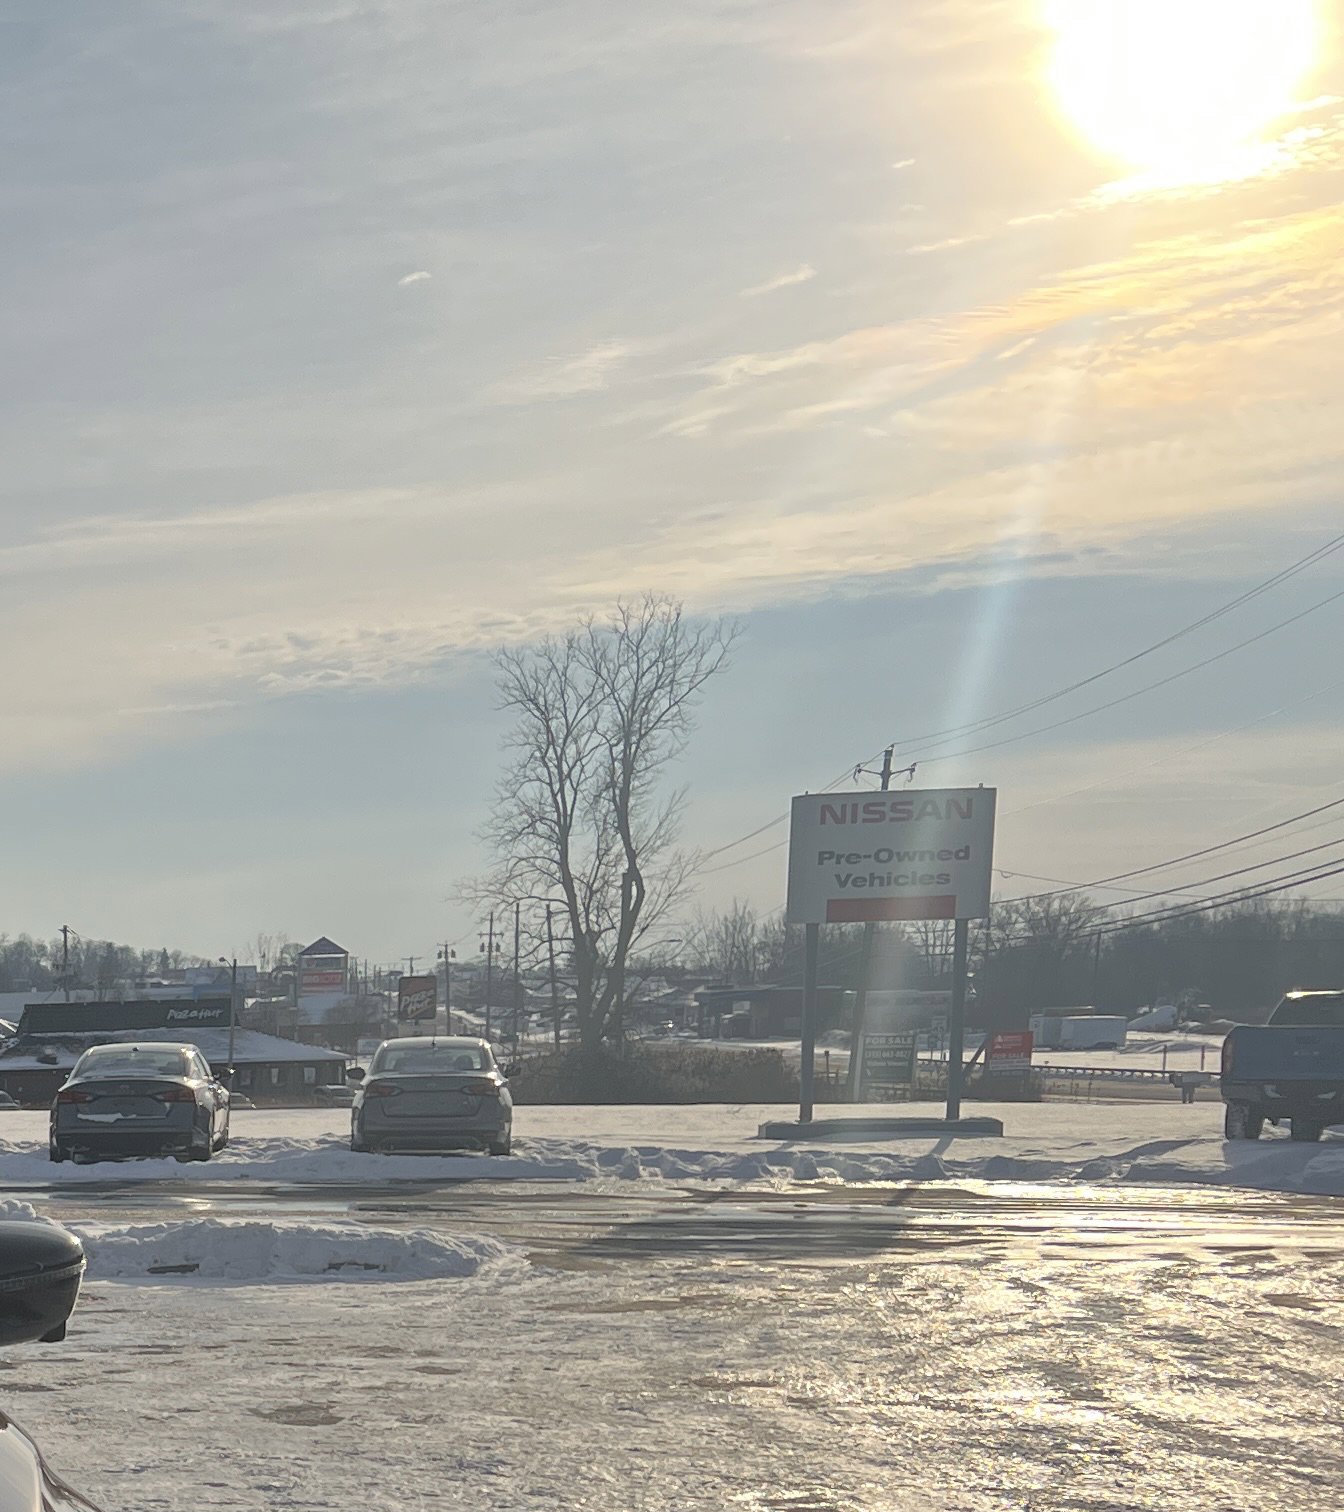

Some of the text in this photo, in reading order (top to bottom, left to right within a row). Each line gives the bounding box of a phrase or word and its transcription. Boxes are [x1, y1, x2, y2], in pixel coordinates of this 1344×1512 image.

[819, 798, 973, 825] NISSAN
[817, 845, 970, 866] Pre-Owned
[834, 872, 951, 889] Vehicles
[865, 1036, 913, 1045] FOR SALE
